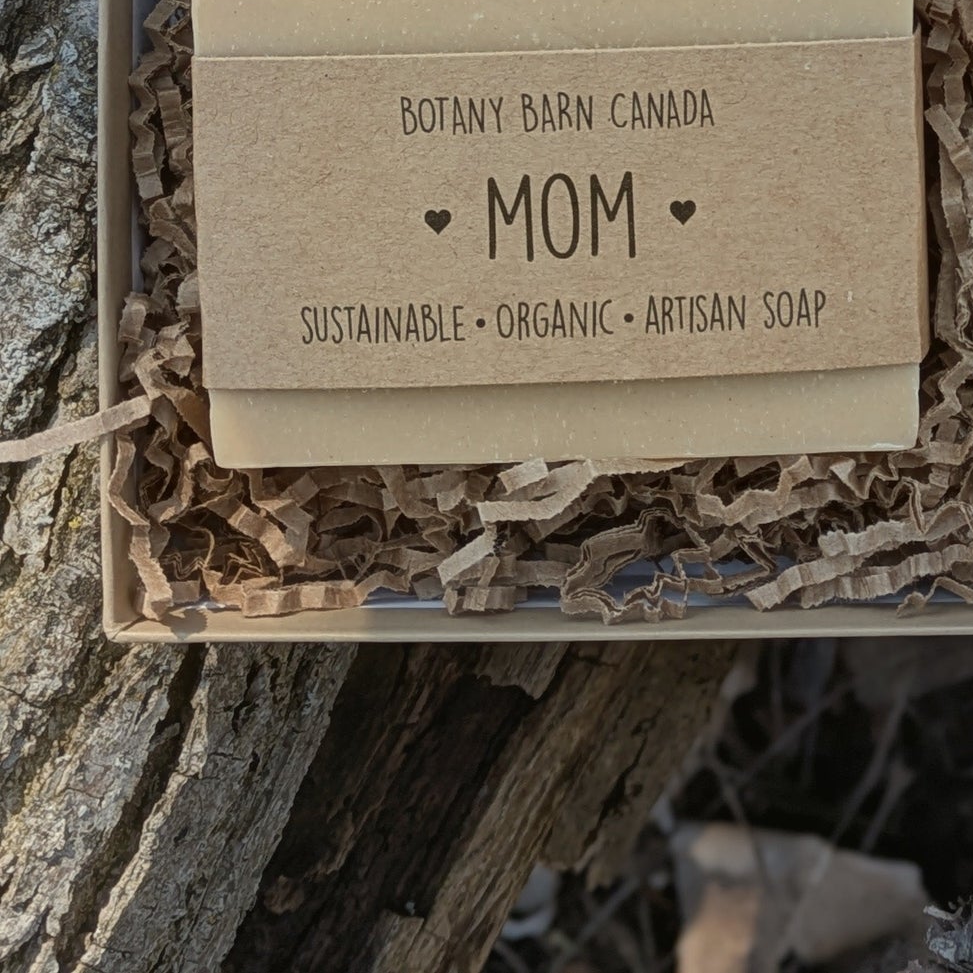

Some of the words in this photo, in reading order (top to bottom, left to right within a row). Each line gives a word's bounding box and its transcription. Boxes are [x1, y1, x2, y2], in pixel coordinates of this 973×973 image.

[401, 94, 504, 136] BOTANY
[522, 93, 593, 133] BARN
[610, 88, 716, 128] CANADA
[486, 170, 638, 263] MOM
[300, 303, 467, 345] SUSTAINABLE
[496, 298, 614, 339] ORGANIC
[644, 293, 747, 336] ARTISAN
[763, 288, 827, 329] SOAP
